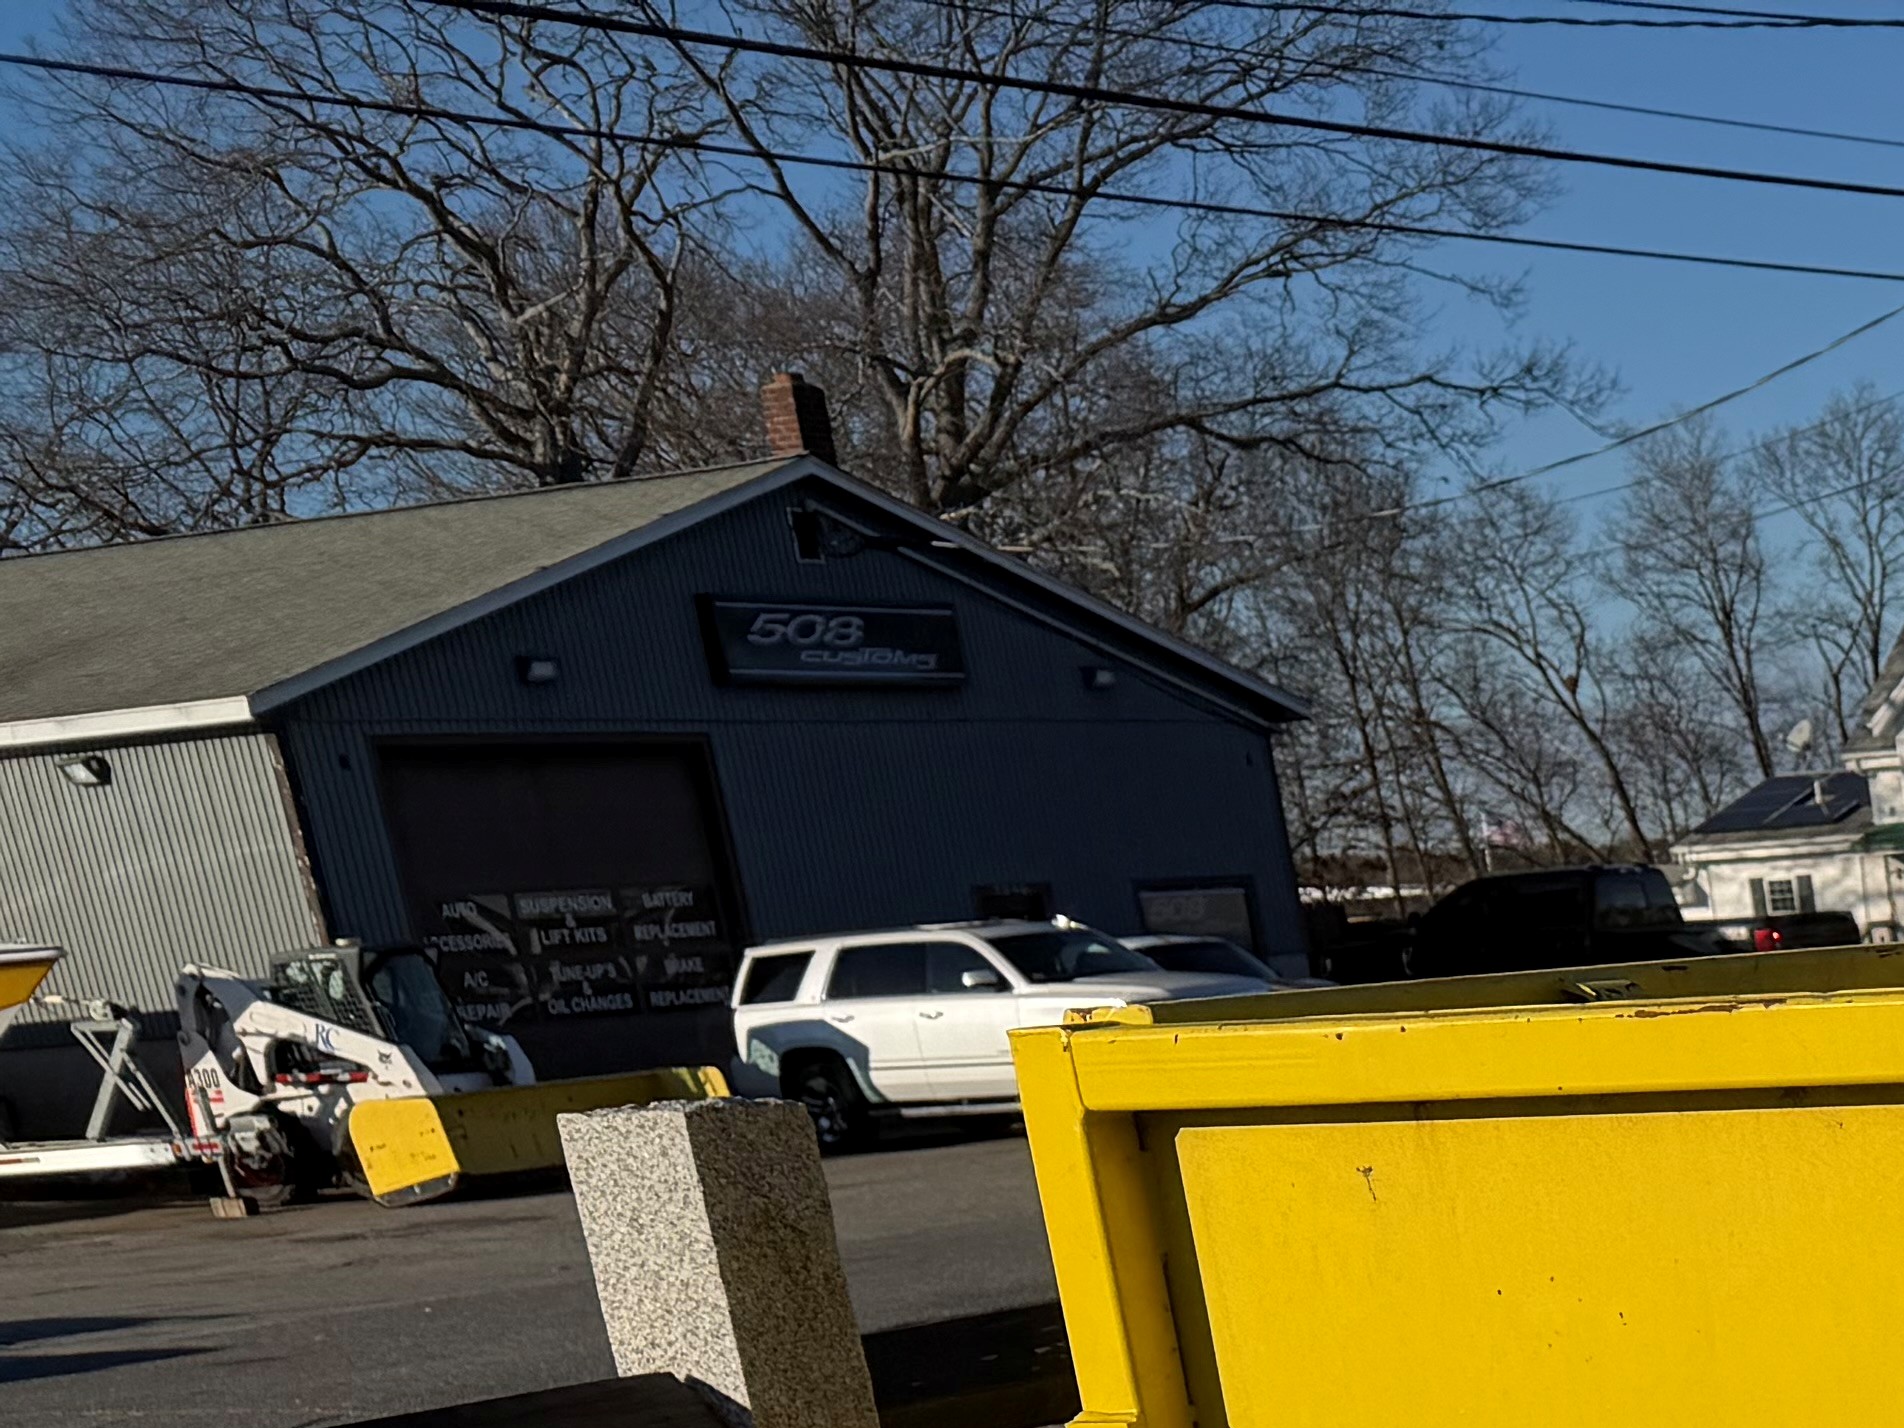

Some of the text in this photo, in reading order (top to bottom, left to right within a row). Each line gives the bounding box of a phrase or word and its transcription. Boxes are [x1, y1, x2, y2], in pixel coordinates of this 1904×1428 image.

[747, 612, 865, 647] 508
[519, 894, 613, 914] SUSPENSION
[641, 890, 694, 909] BATTERY
[442, 901, 478, 920] AUTO
[540, 926, 609, 945] LIFT KITS
[633, 919, 717, 941] REPLACEMENT
[464, 969, 490, 988] A/C
[571, 992, 634, 1012] CHANGES
